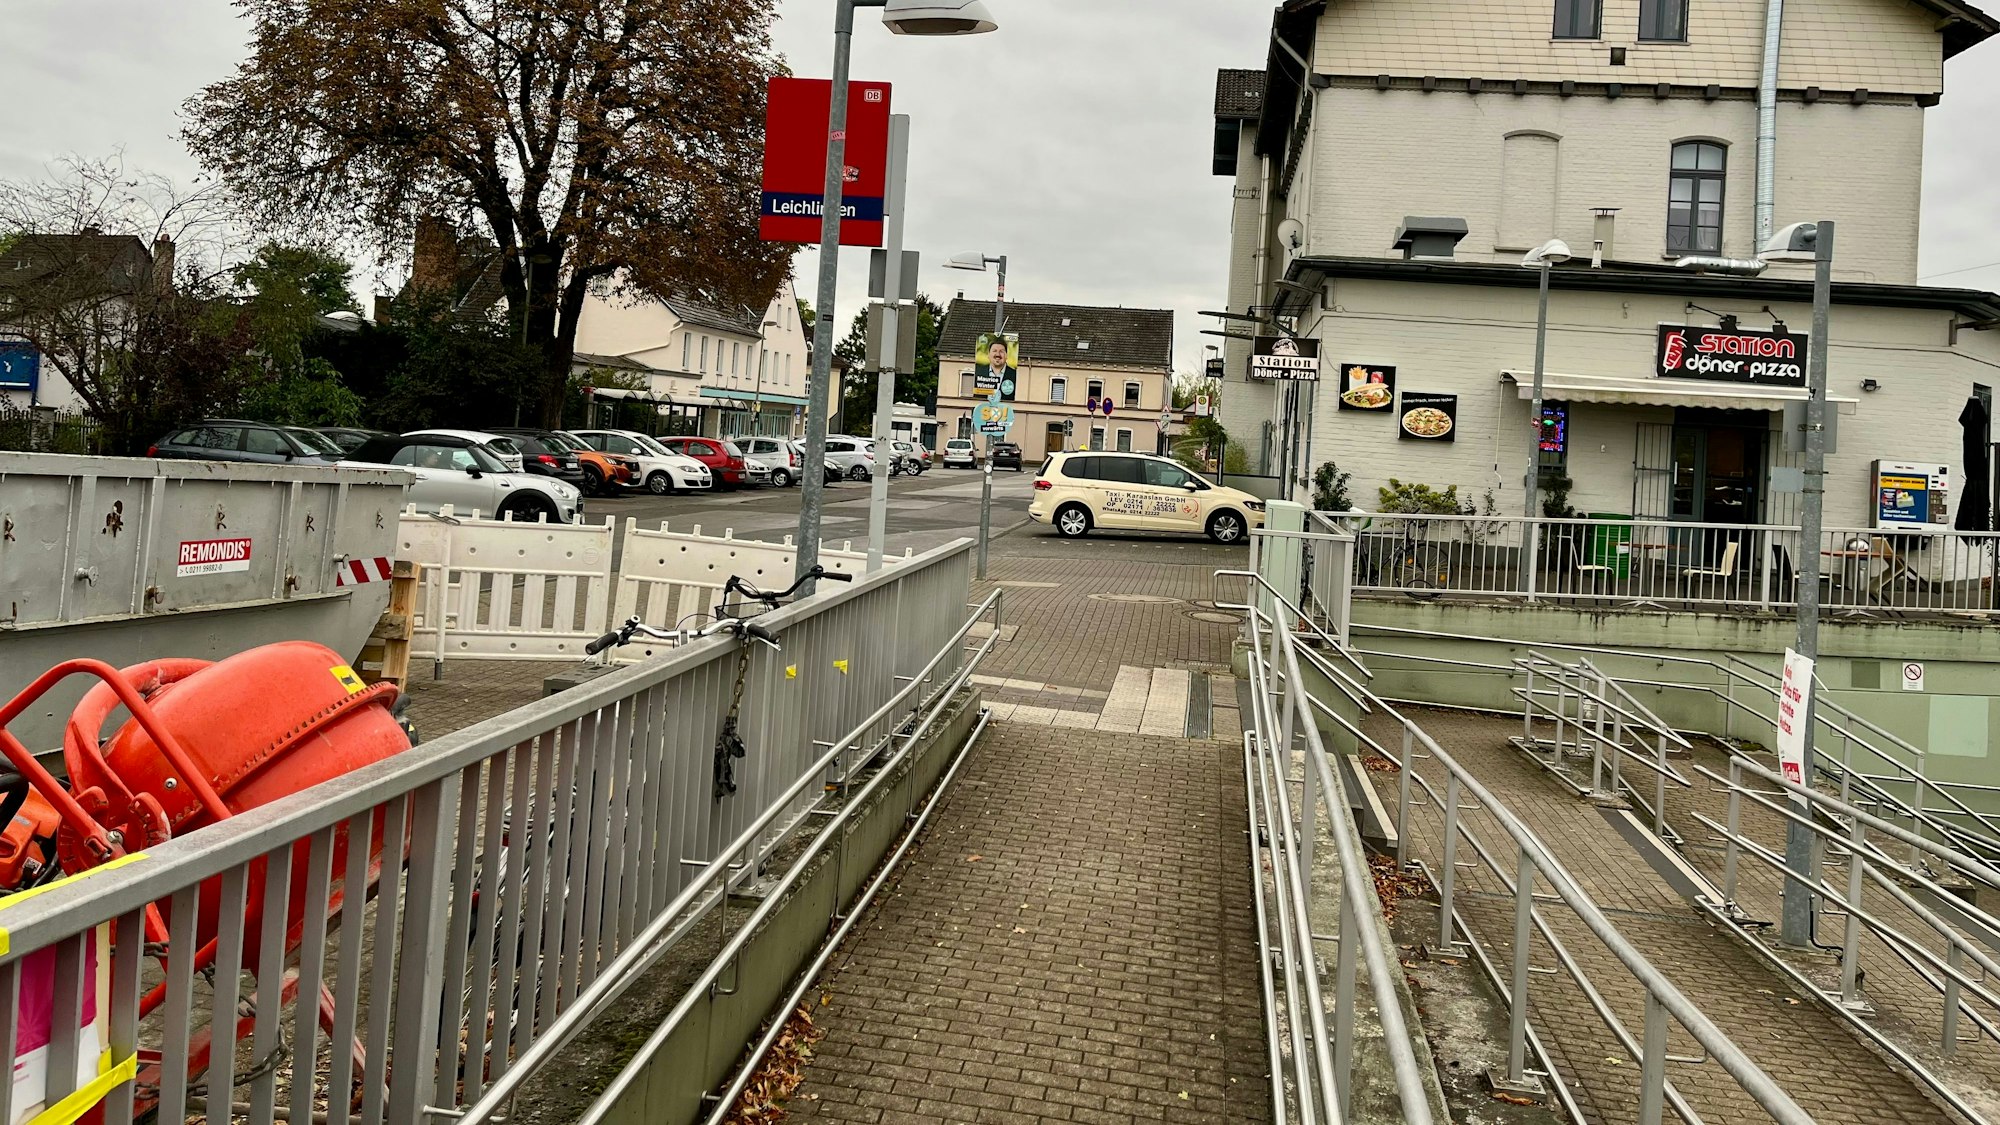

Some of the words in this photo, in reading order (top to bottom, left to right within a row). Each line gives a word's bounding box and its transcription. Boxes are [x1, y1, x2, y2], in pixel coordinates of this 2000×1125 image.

[867, 91, 879, 100] DB
[772, 198, 856, 217] Leichlien
[1259, 356, 1311, 367] Station
[1254, 368, 1282, 378] Döner
[1290, 370, 1315, 380] Pizza
[1750, 361, 1800, 378] pizza
[1126, 492, 1163, 501] Karaaslan
[1102, 506, 1127, 514] WhatsApp
[189, 566, 202, 574] 0211
[1784, 664, 1793, 681] Kein
[1783, 681, 1792, 699] Platz
[1792, 687, 1801, 703] für
[1780, 700, 1794, 718] rechte
